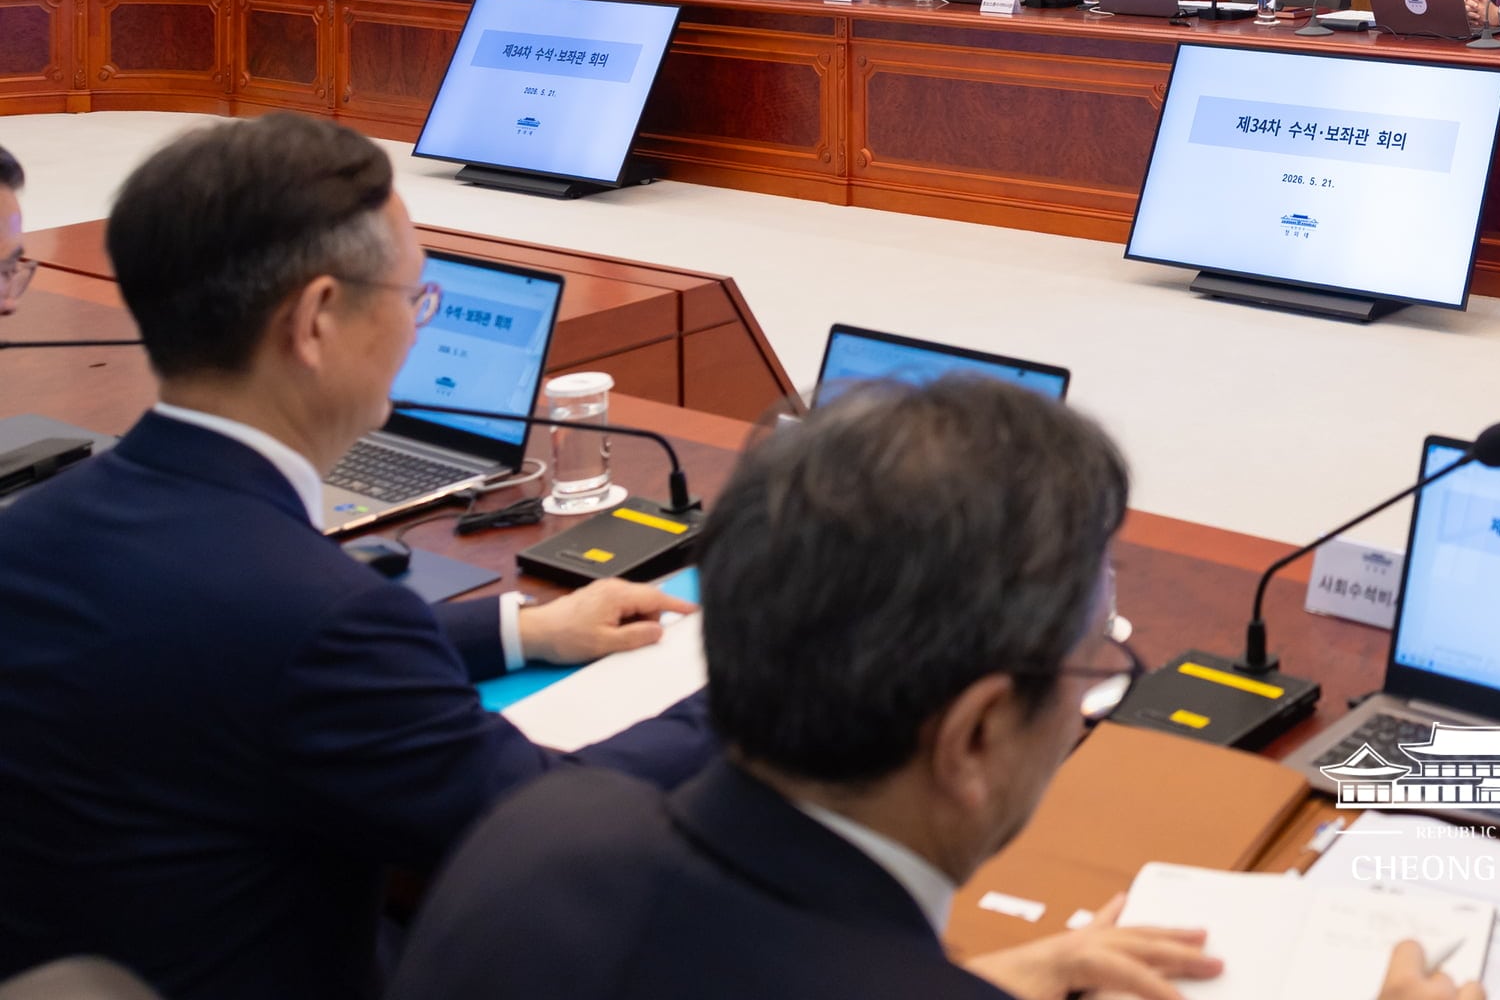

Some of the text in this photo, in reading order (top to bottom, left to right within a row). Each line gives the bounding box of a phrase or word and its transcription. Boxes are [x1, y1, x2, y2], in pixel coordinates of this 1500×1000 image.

[502, 43, 609, 68] 제34차 수석·보좌관 회의
[1236, 115, 1408, 151] 제34차 수석·보좌관 회의
[1282, 173, 1336, 189] 2026. 5. 21.
